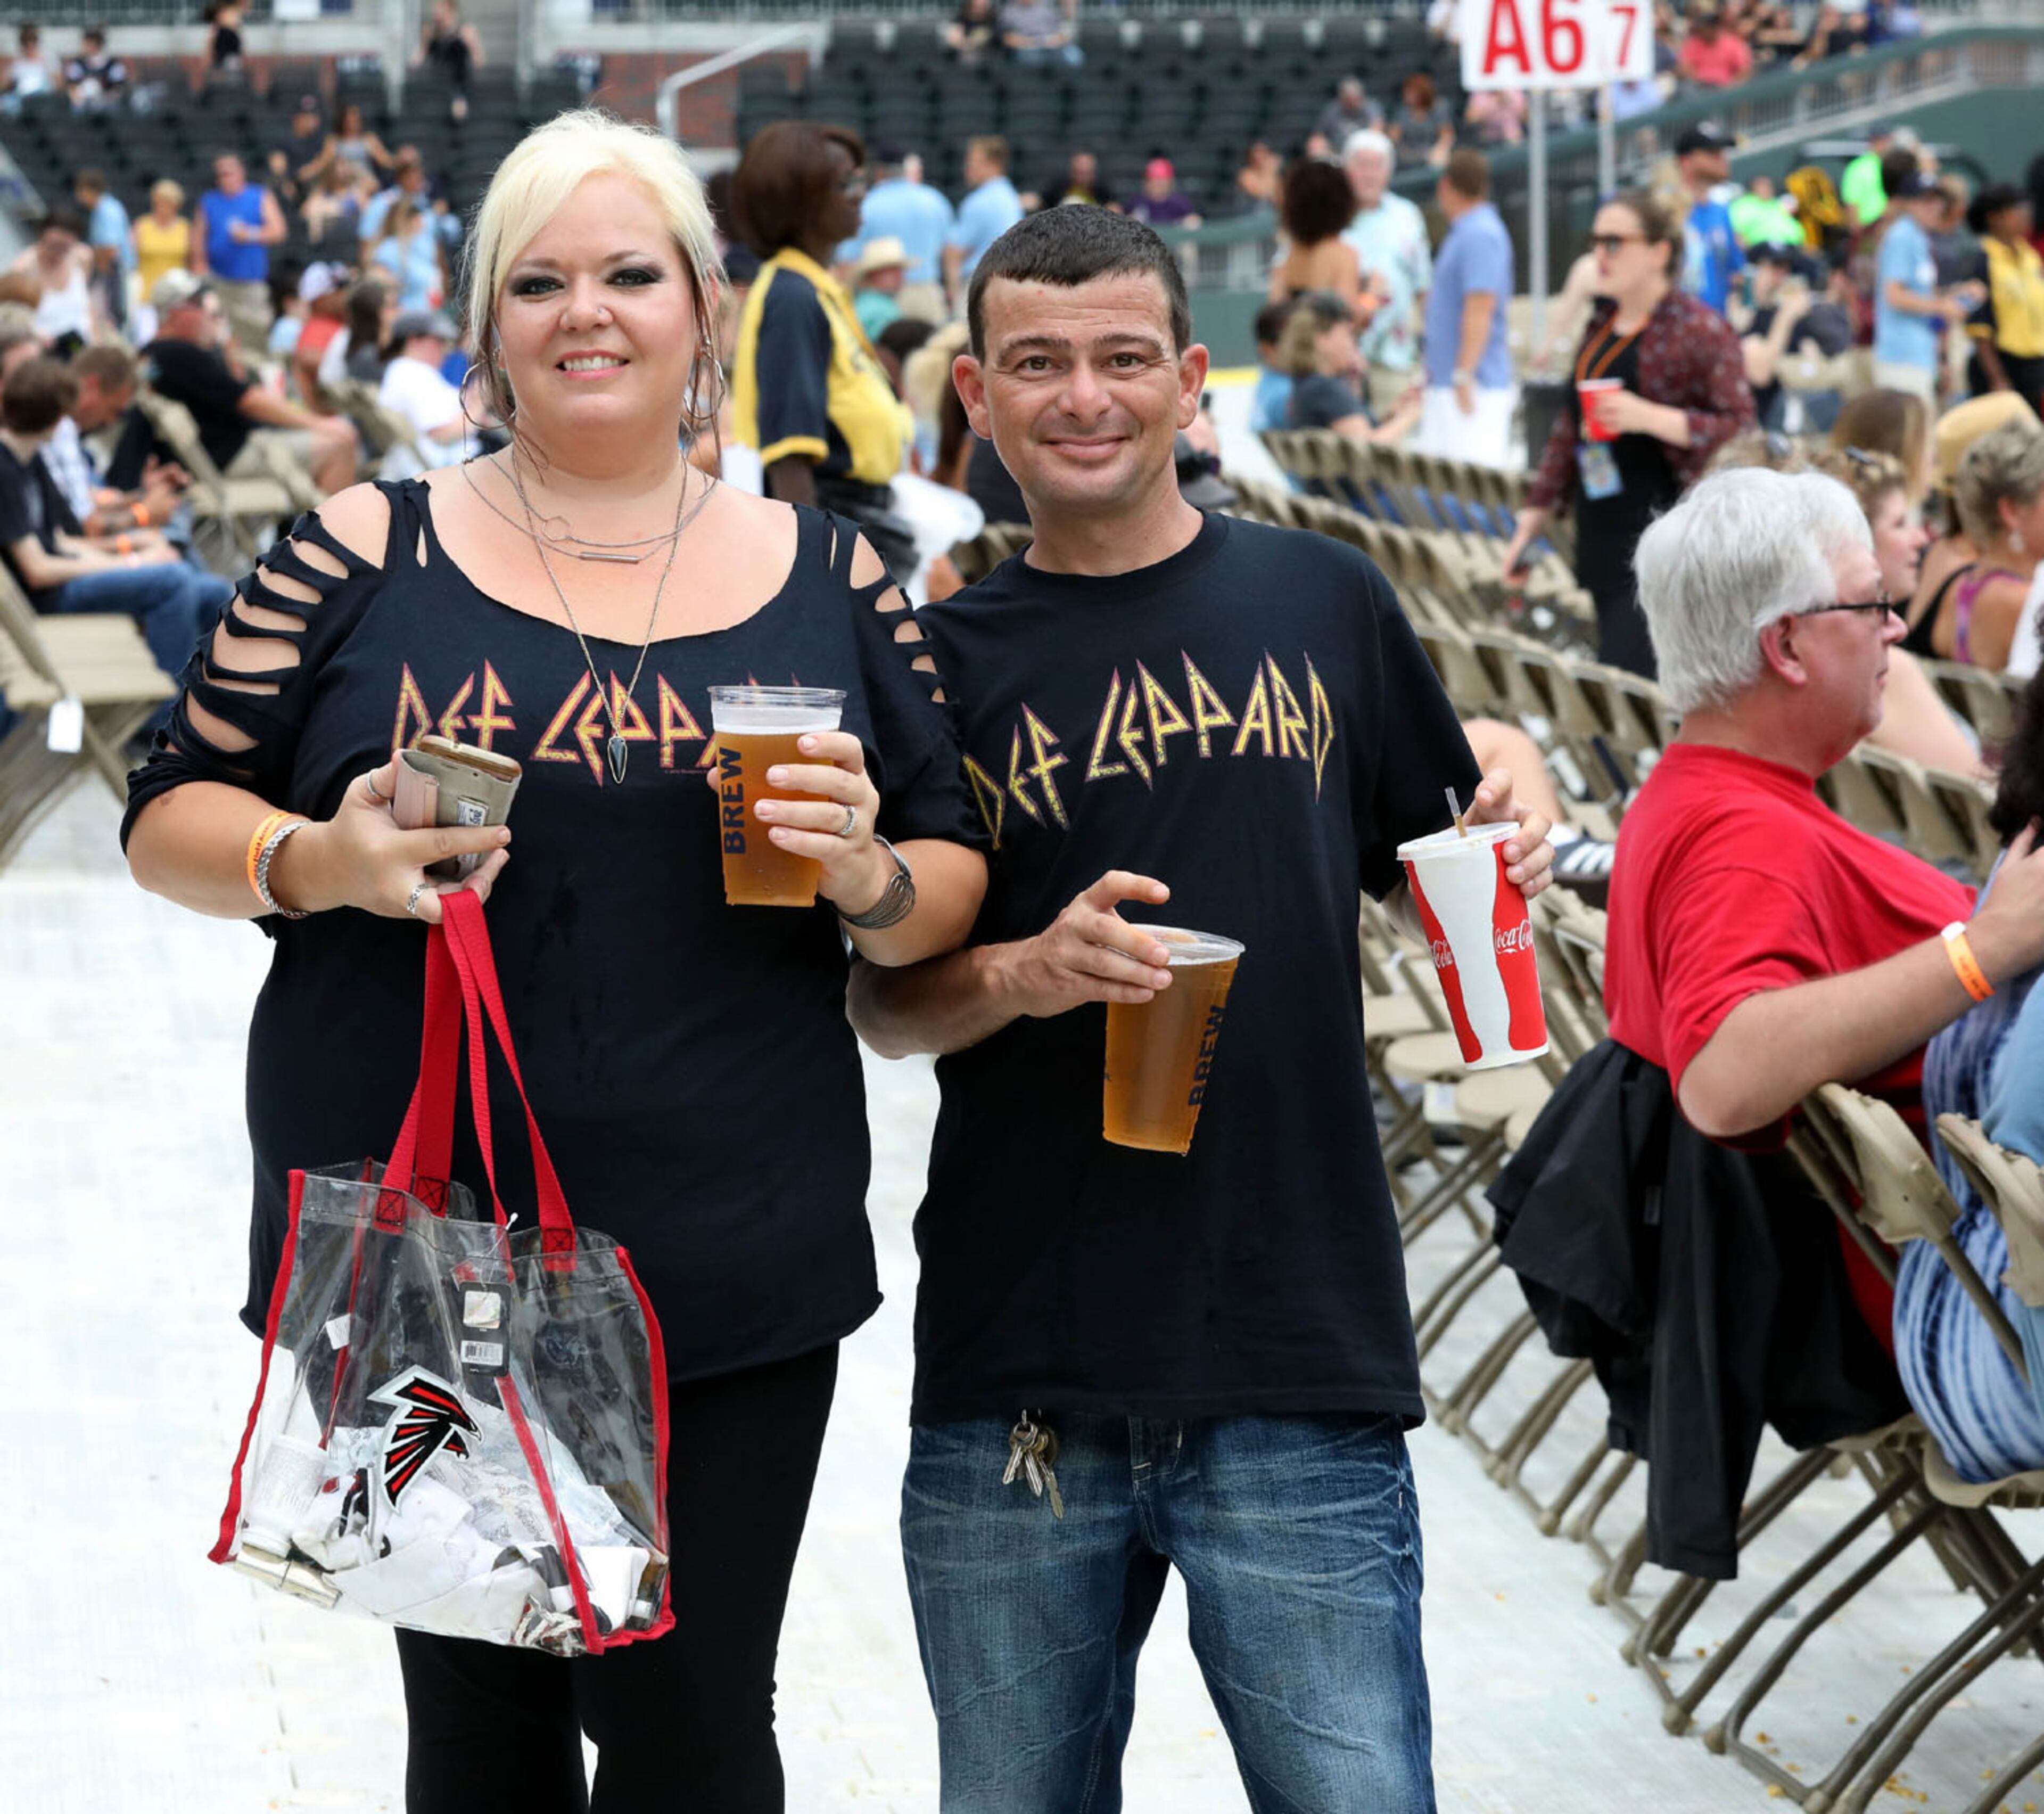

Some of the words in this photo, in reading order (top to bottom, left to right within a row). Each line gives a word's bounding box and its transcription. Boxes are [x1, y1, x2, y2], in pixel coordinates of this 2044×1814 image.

[1482, 0, 1585, 74] A6
[1610, 6, 1639, 68] 7
[530, 668, 801, 787] LEPP
[961, 701, 1069, 851] DEF
[1085, 647, 1334, 805] LEPPARD
[720, 746, 746, 855] BREW
